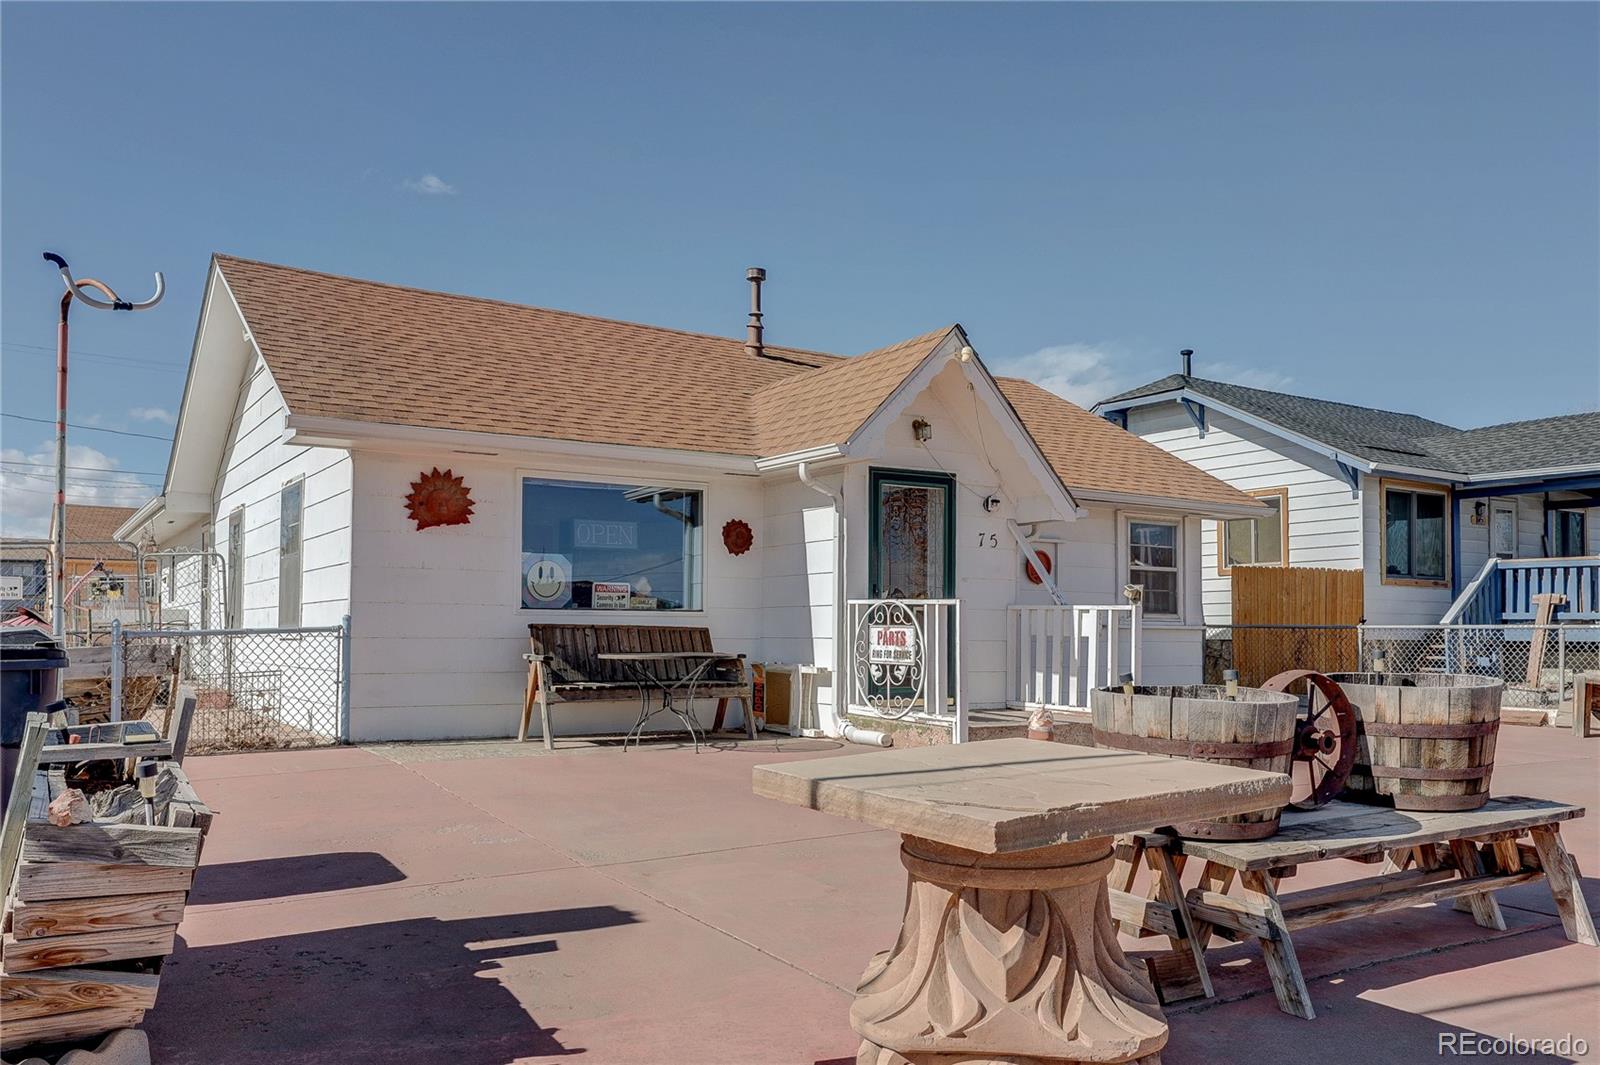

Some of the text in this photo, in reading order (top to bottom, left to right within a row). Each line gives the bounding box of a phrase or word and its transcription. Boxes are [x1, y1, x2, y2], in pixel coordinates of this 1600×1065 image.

[577, 523, 633, 545] OPEN
[979, 532, 998, 548] 75
[596, 584, 628, 592] WARNING
[596, 594, 613, 602] Security
[877, 630, 906, 646] PARTS
[884, 649, 892, 659] FOR
[754, 682, 764, 711] OPEN
